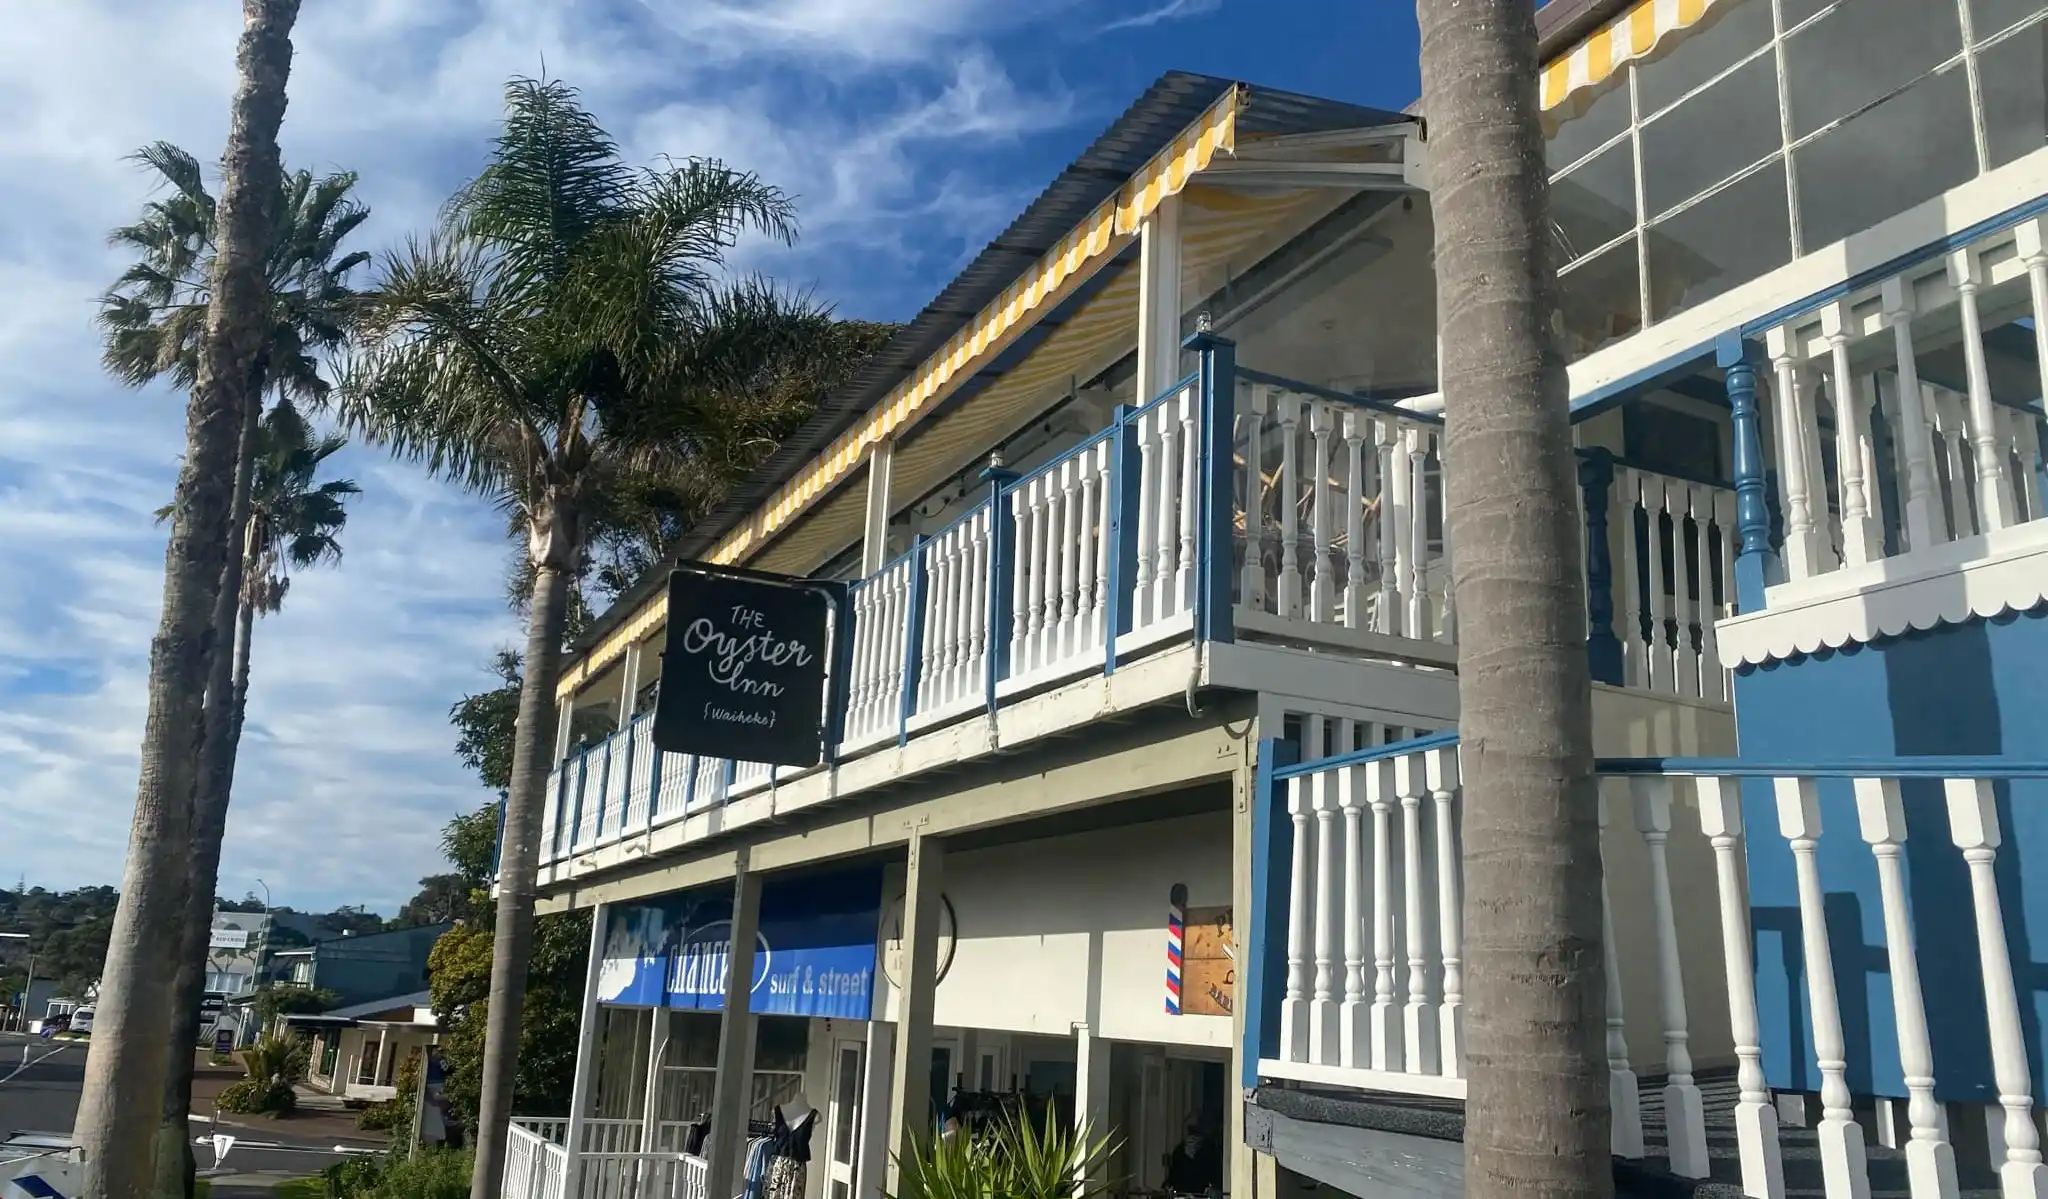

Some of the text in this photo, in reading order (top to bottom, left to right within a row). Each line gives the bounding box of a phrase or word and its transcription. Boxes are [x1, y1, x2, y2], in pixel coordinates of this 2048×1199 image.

[730, 604, 766, 629] THE
[683, 618, 813, 672] Oyster
[709, 660, 785, 697] Inn
[770, 964, 869, 997] surf & street
